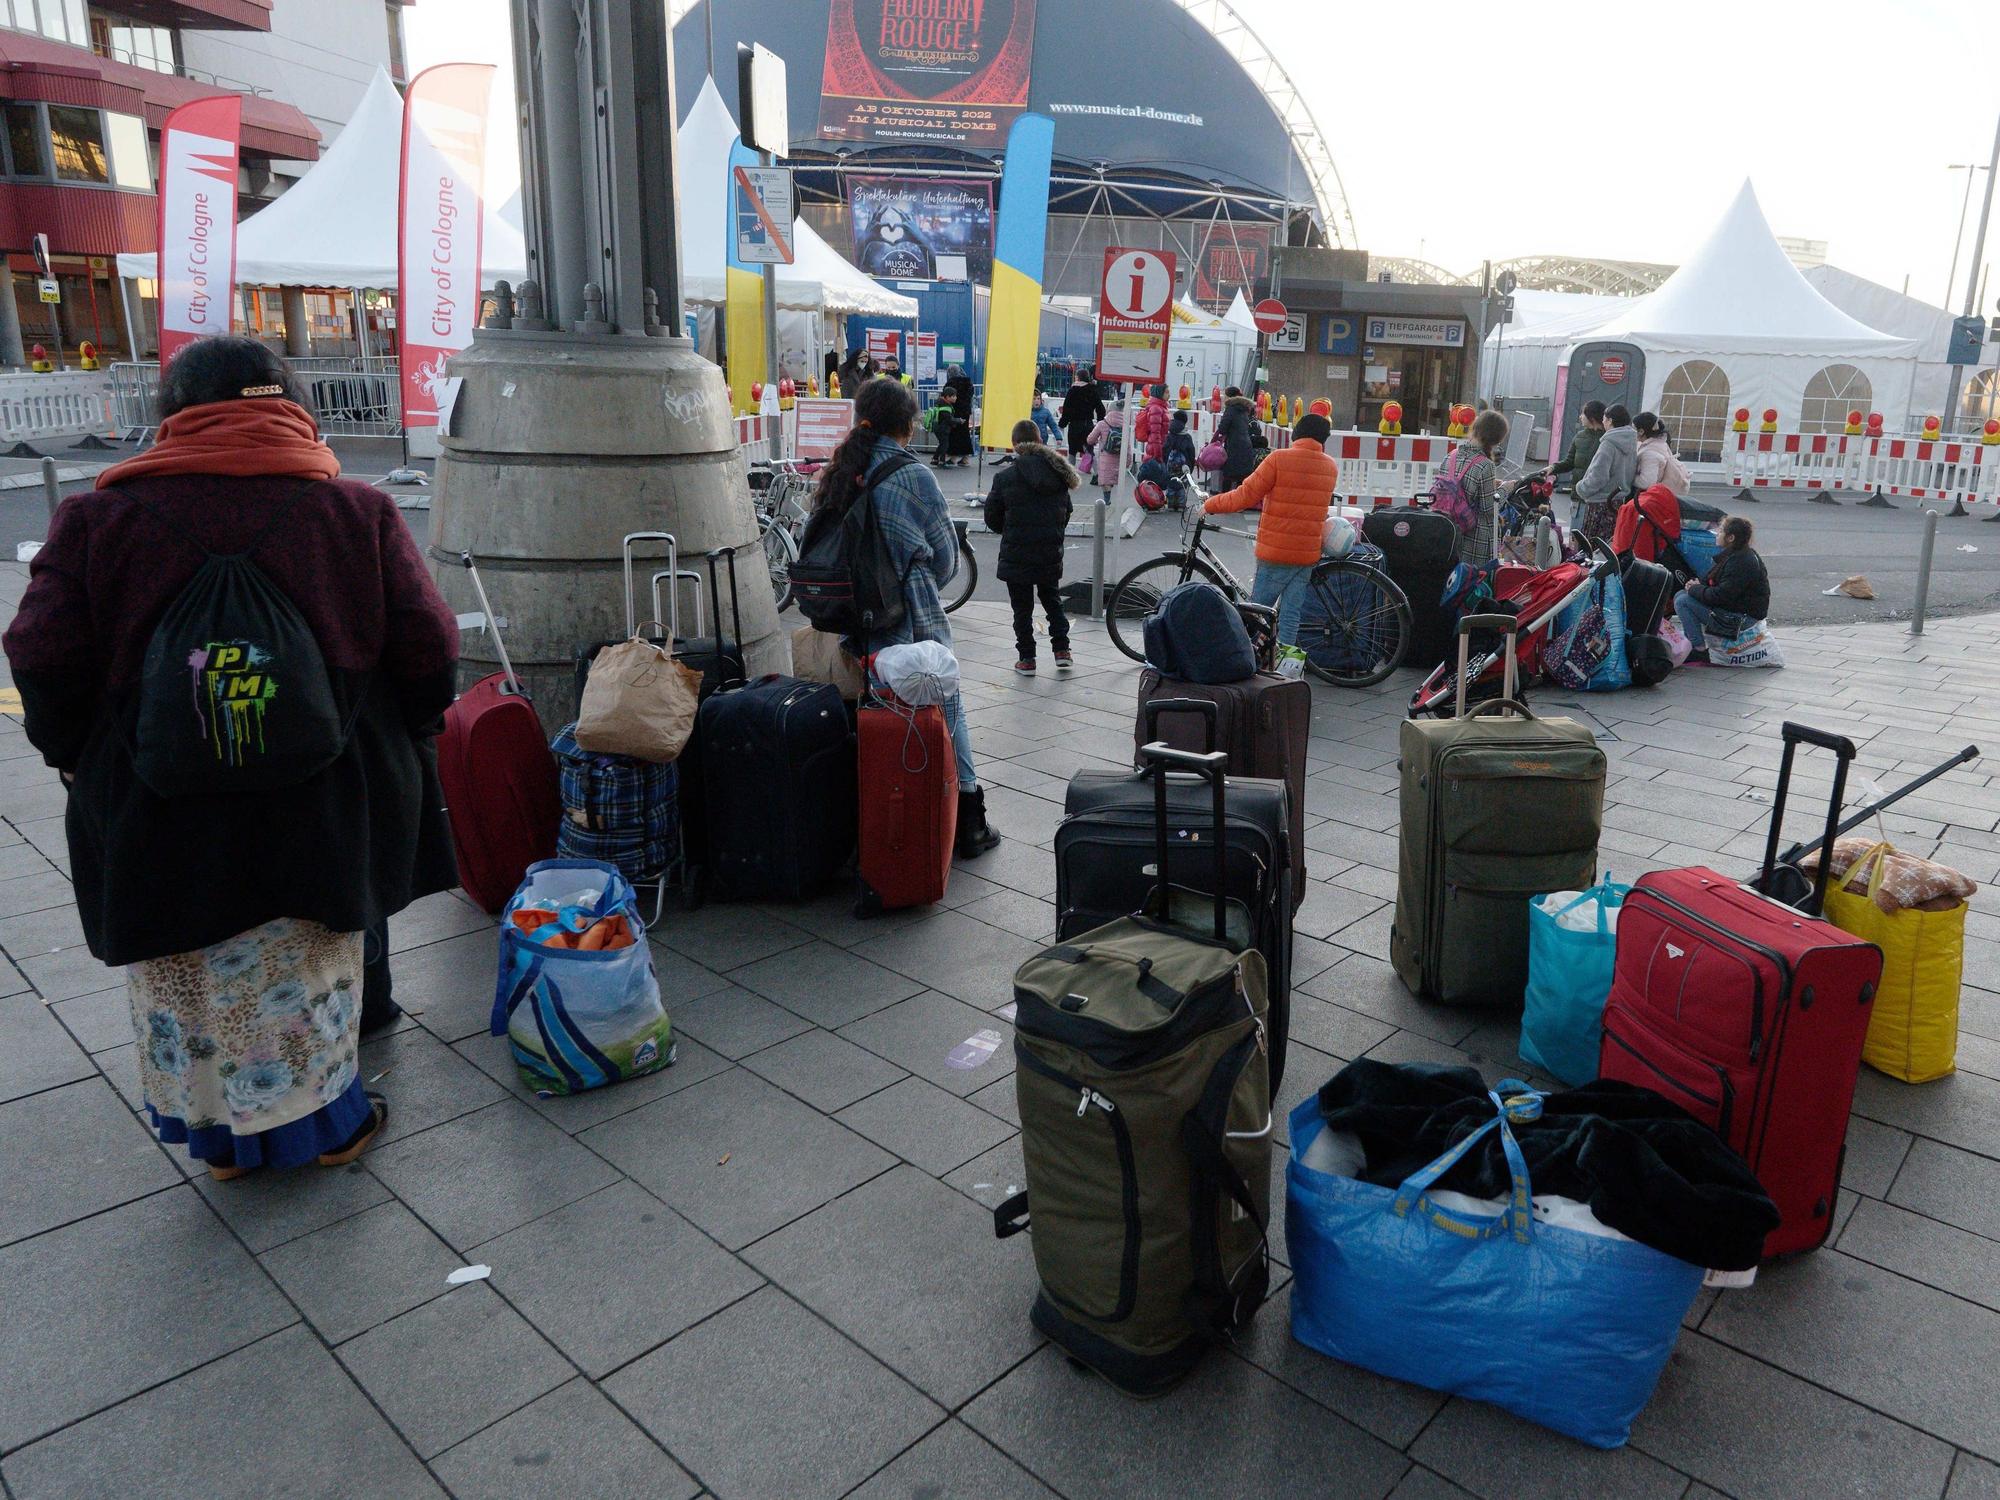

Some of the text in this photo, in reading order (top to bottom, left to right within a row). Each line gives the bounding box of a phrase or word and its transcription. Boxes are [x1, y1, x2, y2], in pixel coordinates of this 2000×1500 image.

[854, 104, 992, 119] AB OKTOBER 2022
[1049, 103, 1204, 126] www.musical-dome.de
[847, 115, 997, 131] IM MUSICAL DOME
[875, 130, 966, 141] MOULIN-ROUGE-MUSICAL.DE
[854, 186, 985, 209] Spektakuläre Unterhaltung
[188, 192, 212, 324] City of Cologne
[431, 176, 457, 337] City of Cologne
[884, 260, 919, 269] MUSICAL
[890, 268, 915, 277] DOME
[1102, 315, 1167, 331] Information
[1388, 322, 1445, 333] TIEFGARAGE
[1327, 319, 1350, 349] P
[1729, 649, 1767, 665] ACTION
